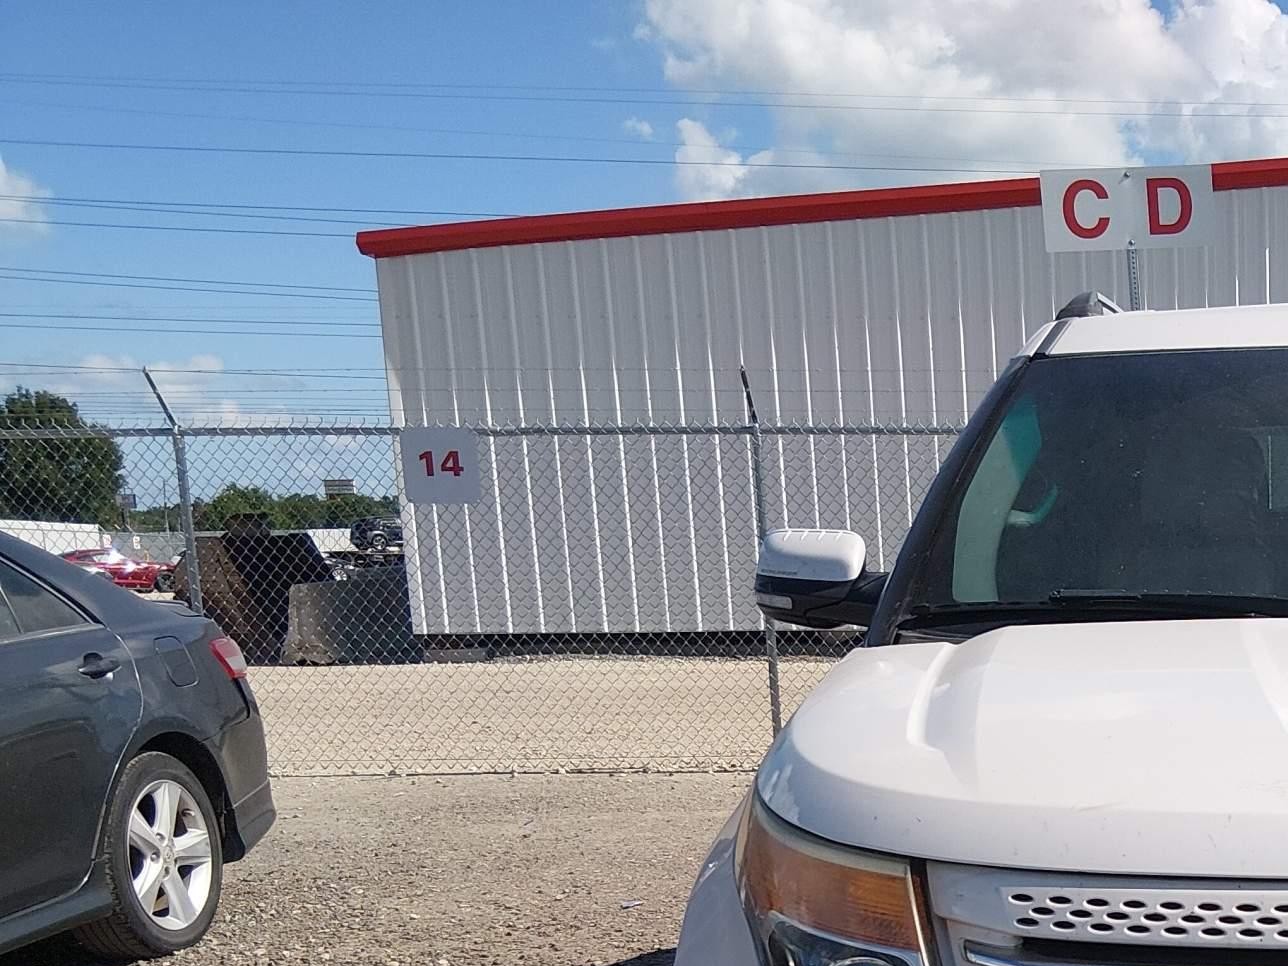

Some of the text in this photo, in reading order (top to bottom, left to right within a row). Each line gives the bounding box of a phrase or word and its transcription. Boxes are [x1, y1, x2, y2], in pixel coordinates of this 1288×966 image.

[1062, 177, 1193, 240] C D
[418, 450, 465, 477] 14
